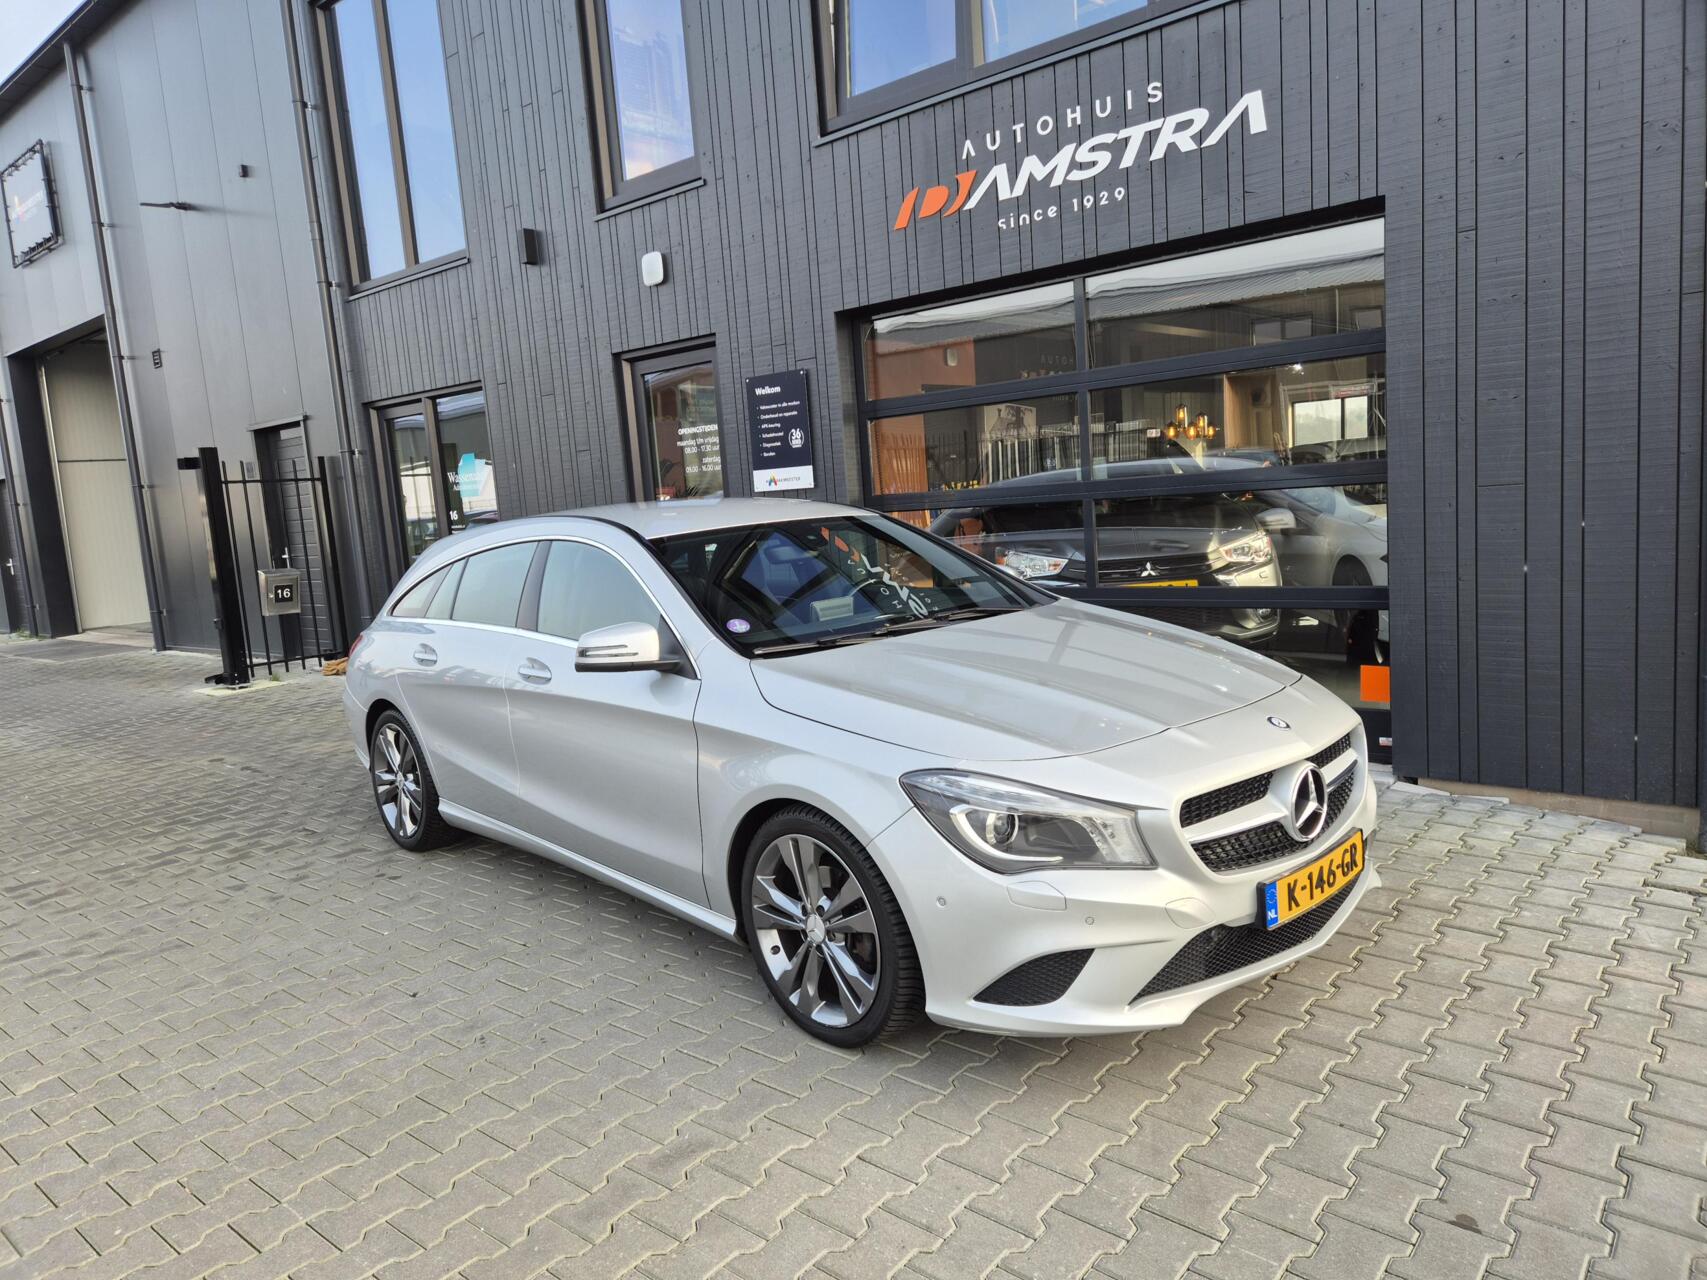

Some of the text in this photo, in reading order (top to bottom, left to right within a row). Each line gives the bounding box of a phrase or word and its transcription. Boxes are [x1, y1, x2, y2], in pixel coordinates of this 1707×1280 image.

[962, 81, 1163, 160] AUTOHUIS
[998, 187, 1126, 230] since 1929
[755, 386, 781, 396] Welkom
[678, 424, 719, 435] OPENINGSTIJDEN
[791, 428, 801, 440] 36
[449, 511, 459, 521] 16
[277, 588, 291, 599] 16
[1287, 842, 1358, 911] K-146-GR
[1268, 909, 1278, 920] NL
